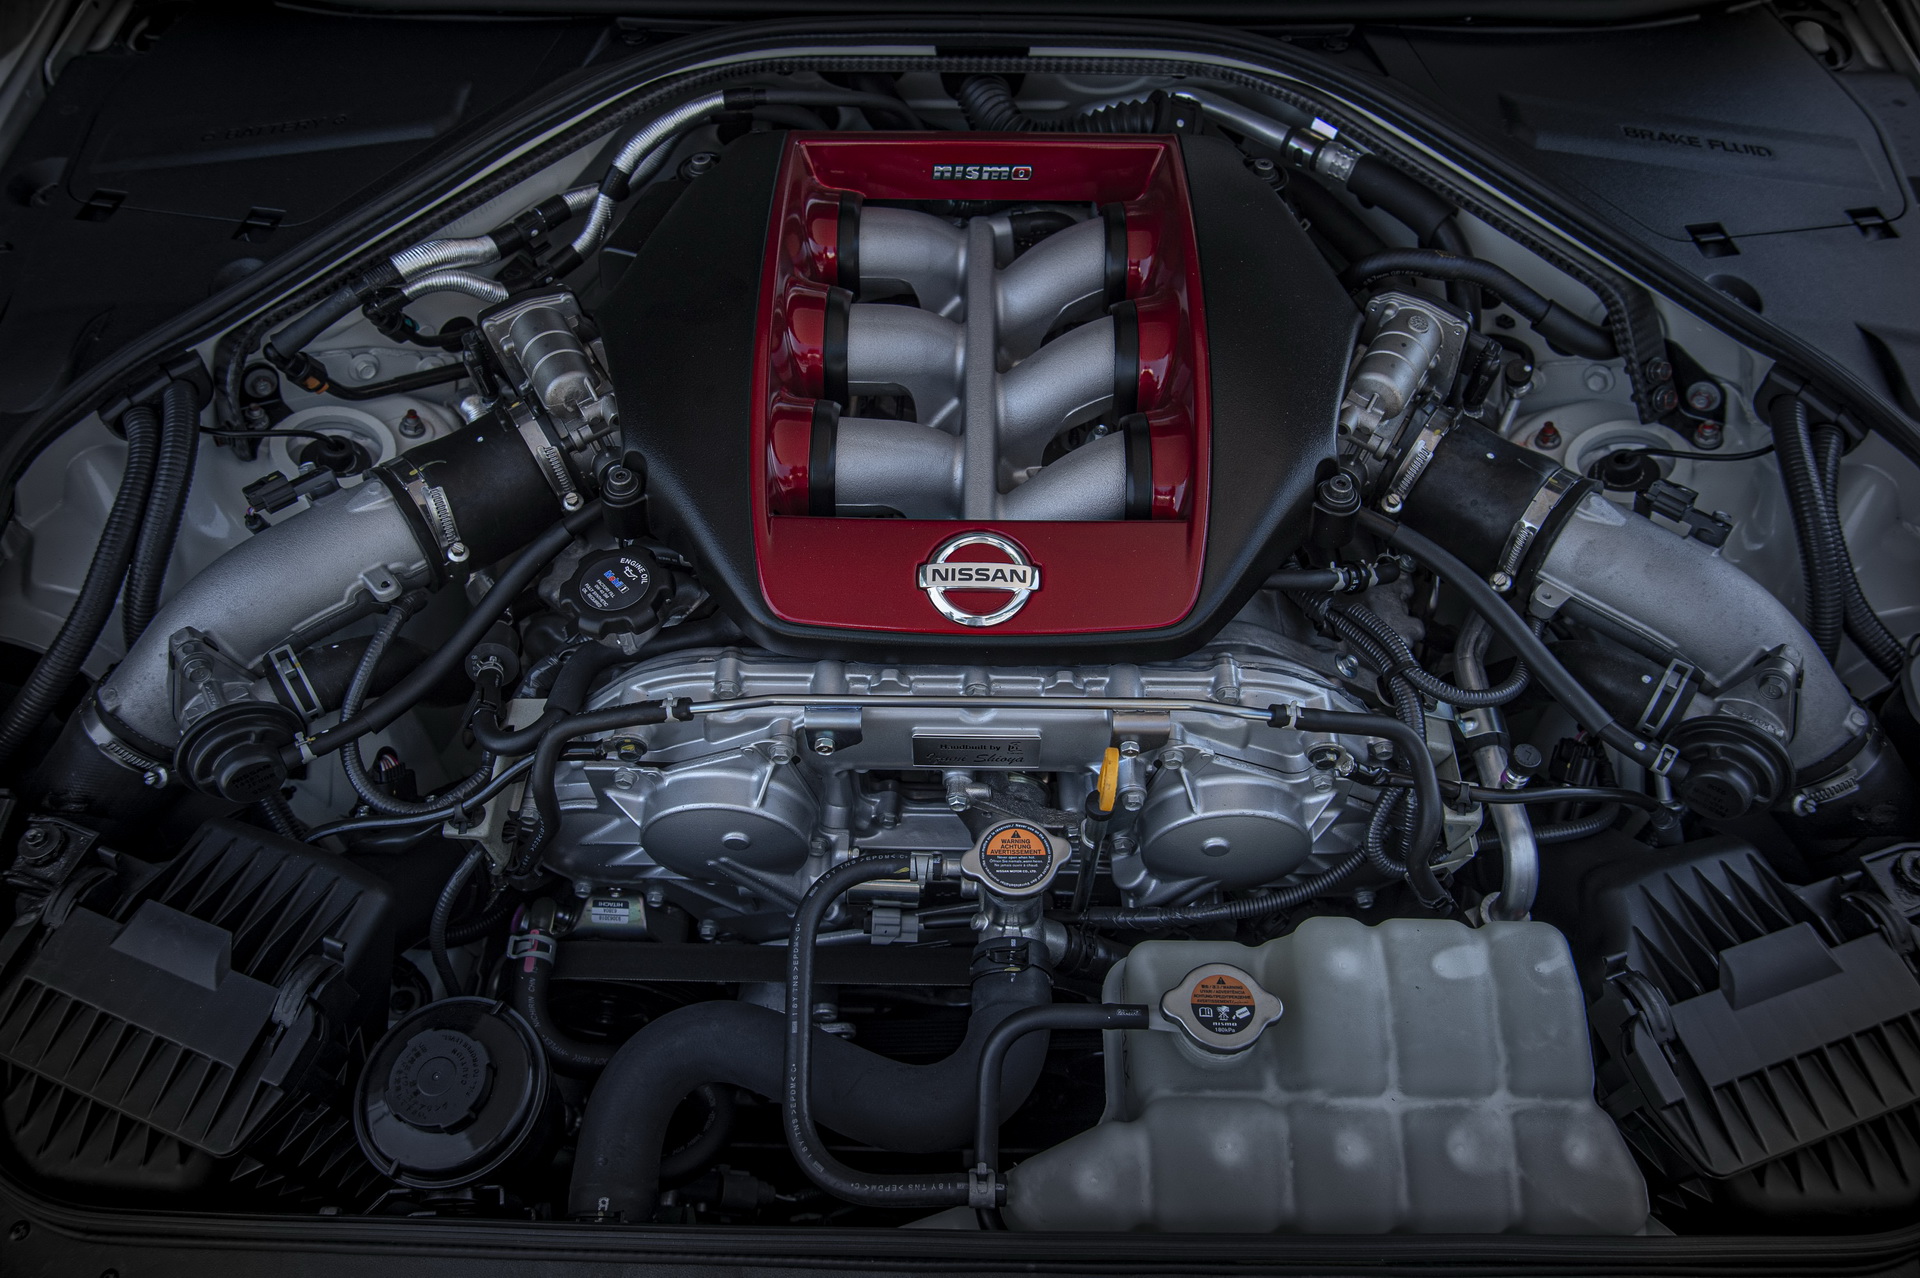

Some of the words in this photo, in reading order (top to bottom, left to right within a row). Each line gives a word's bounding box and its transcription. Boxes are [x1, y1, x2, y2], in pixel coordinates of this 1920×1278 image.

[225, 117, 327, 140] BATTERY
[1623, 125, 1702, 149] BRAKE
[1706, 138, 1773, 157] FLUID
[933, 164, 1033, 180] nismo
[603, 569, 624, 588] Mobil
[620, 557, 646, 574] ENGINE
[640, 573, 648, 585] OIL
[931, 567, 1027, 584] NISSAN
[528, 977, 536, 993] CHN
[528, 995, 541, 1028] NICHIRIN
[452, 1048, 470, 1086] CAUTION
